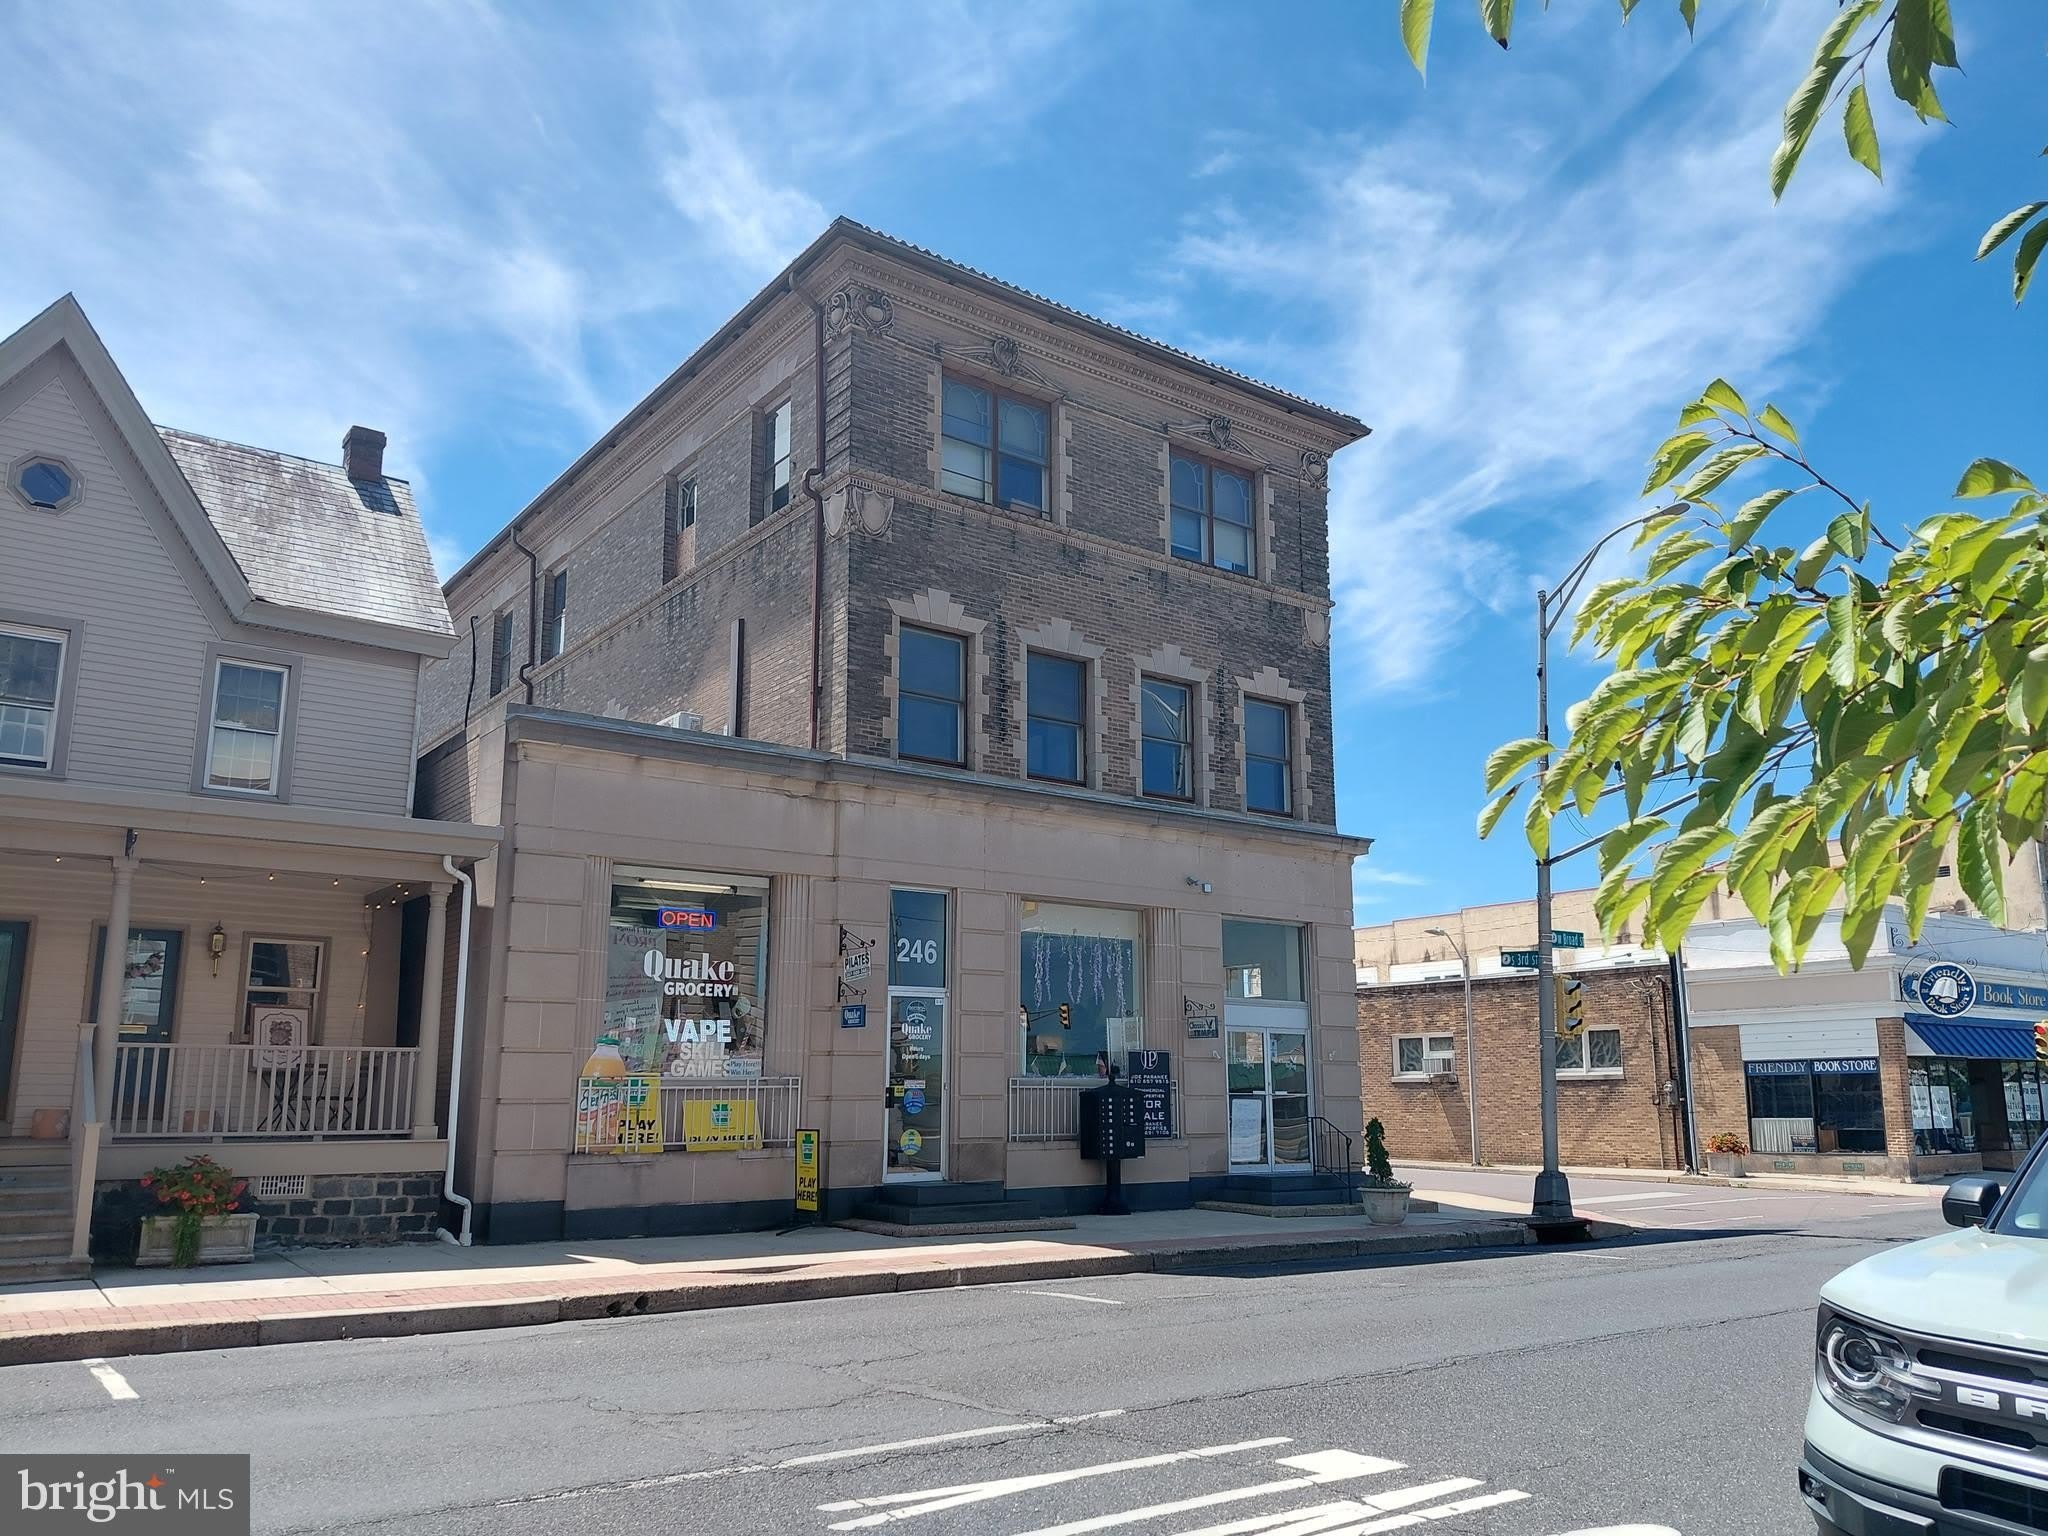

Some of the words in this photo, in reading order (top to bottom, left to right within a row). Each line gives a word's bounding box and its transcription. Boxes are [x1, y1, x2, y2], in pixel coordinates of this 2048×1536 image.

[662, 911, 713, 928] OPEN
[1563, 934, 1578, 945] Broad
[897, 938, 937, 964] 246
[1517, 953, 1528, 965] 3rd
[644, 950, 734, 981] Quake
[845, 952, 870, 969] PILATES
[1923, 968, 1967, 987] Friendly
[664, 982, 731, 997] GROCERY
[1983, 984, 2013, 1005] Book
[2018, 987, 2046, 1007] Store
[1926, 996, 1948, 1014] Book
[1950, 994, 1970, 1013] Store
[844, 1009, 860, 1020] Quake
[664, 1019, 731, 1042] VAPE
[902, 1023, 931, 1035] Quake
[680, 1042, 729, 1060] SKILL
[671, 1060, 730, 1077] GAMES
[1748, 1062, 1806, 1073] FRIENDLY
[1814, 1060, 1841, 1072] BOOK
[1842, 1060, 1877, 1071] STORE
[1144, 1100, 1161, 1109] OR
[1144, 1111, 1165, 1120] ALE
[619, 1120, 656, 1130] PLAY
[799, 1177, 816, 1188] PLAY
